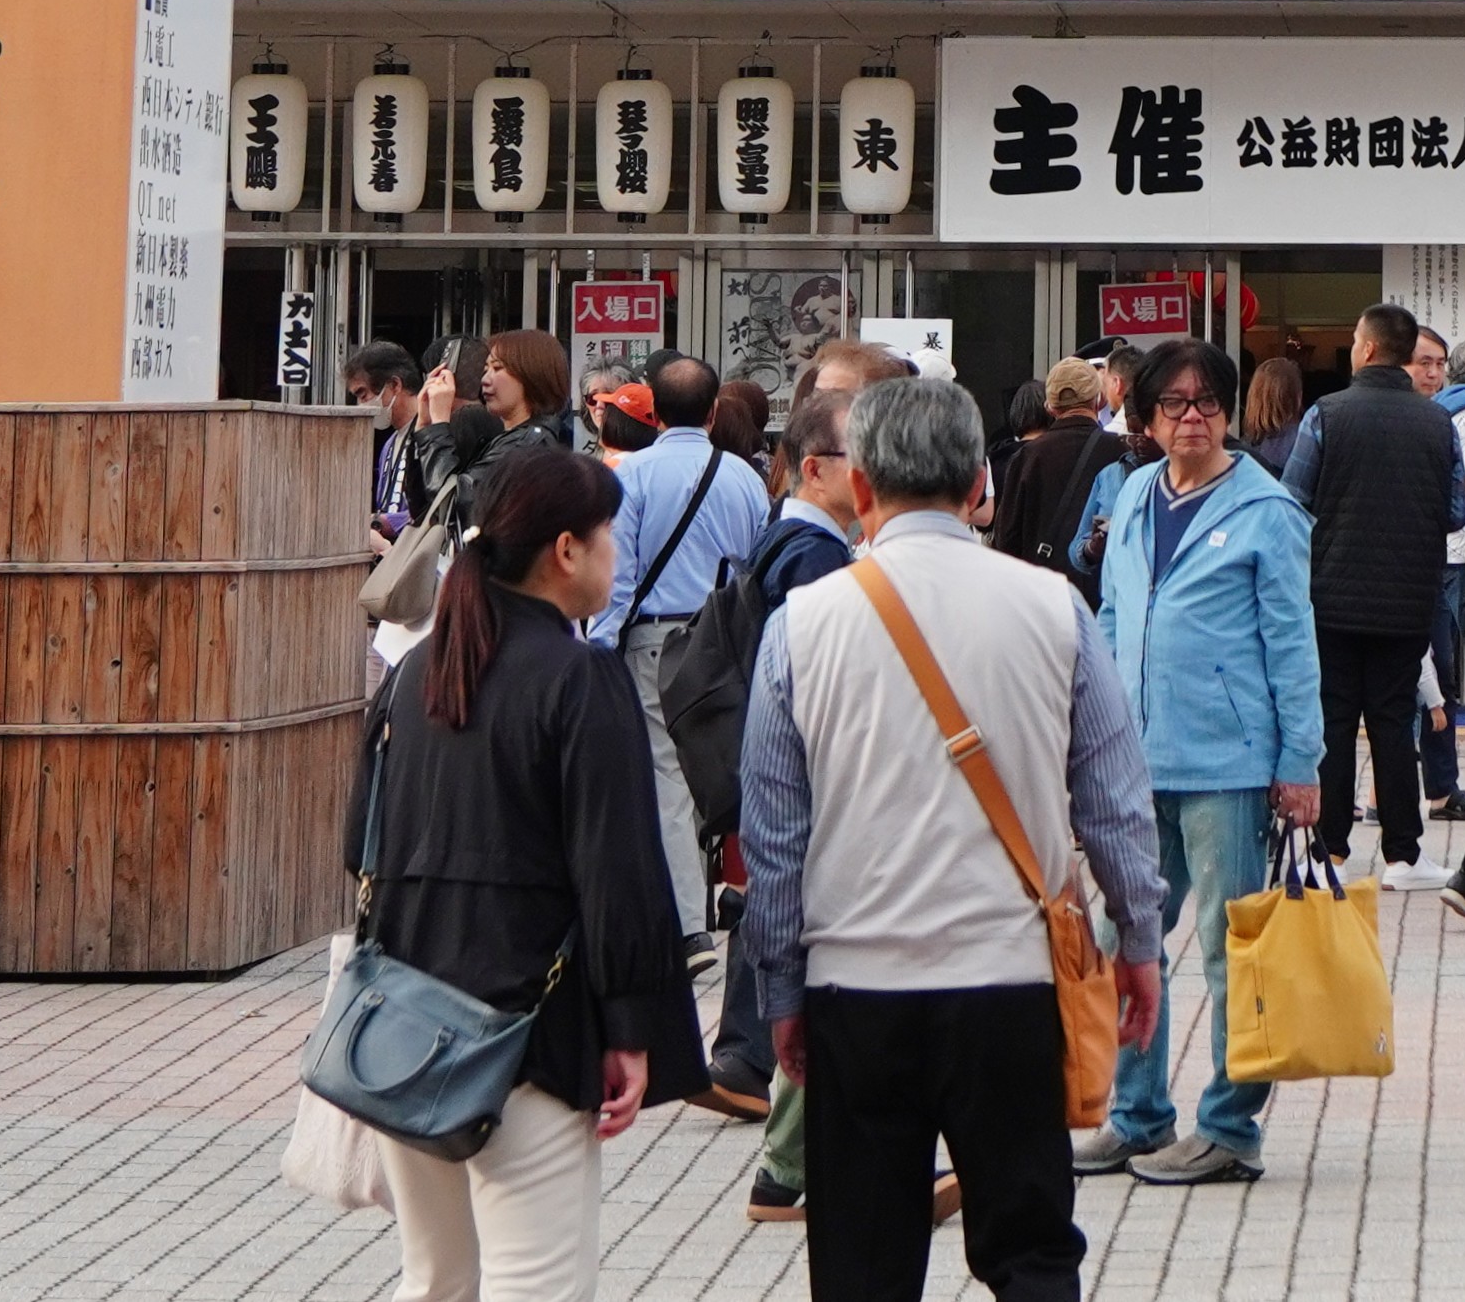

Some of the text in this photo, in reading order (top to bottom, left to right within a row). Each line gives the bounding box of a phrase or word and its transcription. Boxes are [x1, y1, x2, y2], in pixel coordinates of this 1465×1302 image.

[143, 19, 175, 68] 九電工
[141, 75, 224, 136] 西日本シティ銀行
[139, 125, 182, 176] 出水酒造
[368, 94, 398, 192] 若元春
[488, 96, 526, 193] 霧島
[851, 118, 900, 173] 東
[988, 84, 1206, 196] 主催
[158, 193, 177, 224] net
[135, 228, 189, 280] 新日本製薬
[133, 281, 177, 331] 九州電力
[577, 295, 657, 322] 入場口
[1105, 296, 1184, 324] 入場口
[131, 336, 173, 380] 西部ガス
[283, 294, 313, 386] 力士入口
